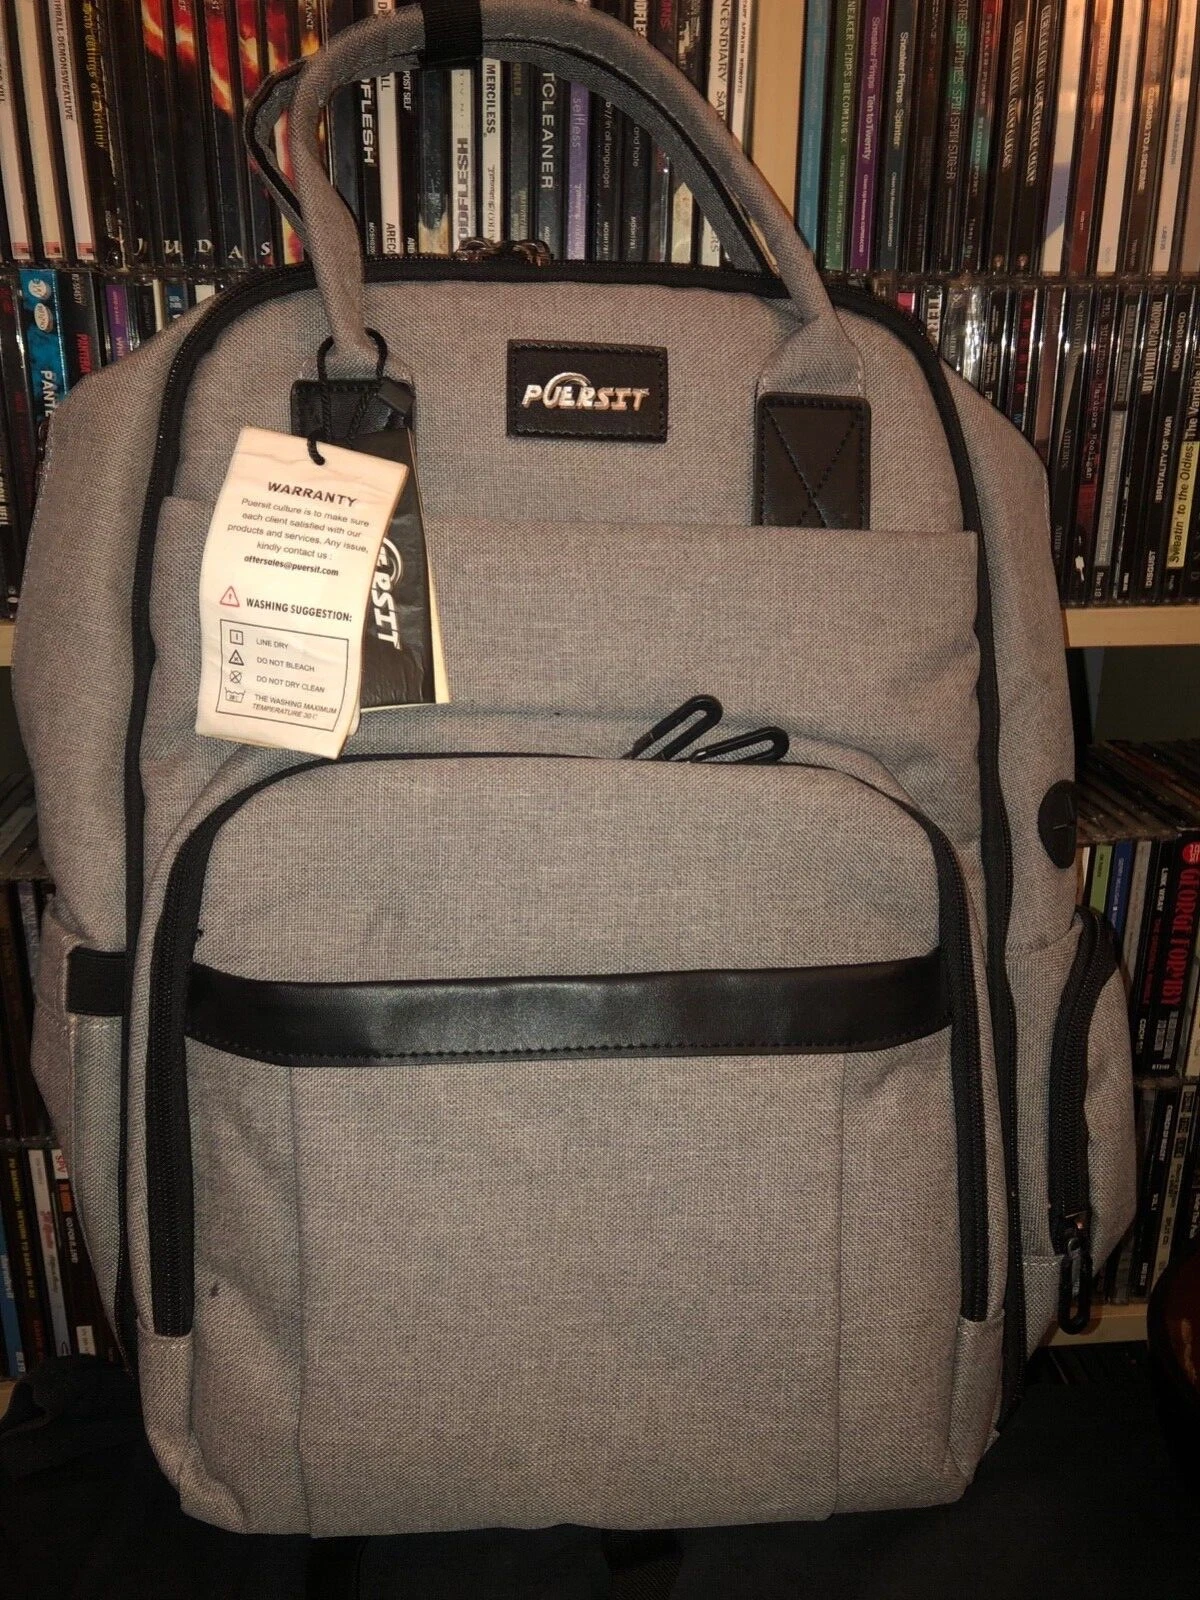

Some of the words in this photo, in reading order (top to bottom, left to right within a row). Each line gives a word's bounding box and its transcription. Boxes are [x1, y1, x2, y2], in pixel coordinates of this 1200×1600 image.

[844, 0, 857, 42] NEAKER
[869, 16, 881, 57] Sneaker
[717, 0, 732, 83] NCENDIARY
[898, 31, 910, 73] Sneaker
[843, 44, 853, 78] PIMPS
[866, 58, 877, 89] Pimps
[402, 70, 412, 91] POST
[895, 73, 906, 104] Pimps
[402, 92, 412, 111] SELF
[485, 64, 497, 135] MERCILESS
[840, 82, 850, 135] BECOMING
[866, 94, 876, 113] Ten
[360, 78, 375, 163] FLESH
[541, 72, 556, 189] TCLEANER
[571, 97, 589, 149] selfless
[893, 107, 905, 147] Splinter
[863, 123, 874, 161] Twenty
[457, 137, 469, 241] ODFLESH
[1147, 300, 1164, 346] DROPDEAD
[1171, 341, 1183, 370] MOSH
[40, 370, 56, 418] PANT
[522, 372, 650, 411] PUERSIT
[1163, 415, 1173, 437] WAR
[1184, 417, 1199, 440] The
[1084, 433, 1099, 480] Hooligan
[1161, 437, 1171, 451] OF
[1154, 452, 1169, 503] BRUTALITY
[1179, 484, 1189, 501] the
[267, 481, 357, 508] WARRANTY
[1177, 503, 1187, 515] to
[241, 497, 272, 510] Puersit
[272, 503, 302, 514] culture
[304, 508, 312, 516] is
[313, 510, 322, 518] to
[324, 511, 348, 523] make
[350, 518, 370, 528] sure
[242, 512, 263, 522] each
[264, 515, 288, 526] client
[289, 521, 325, 532] satisfied
[327, 525, 345, 536] with
[346, 530, 363, 538] our
[227, 523, 265, 535] products
[265, 528, 283, 538] and
[323, 537, 343, 549] Any
[256, 541, 283, 554] kindly
[283, 547, 316, 558] contact
[243, 554, 339, 577] aftersales@puersit.com
[1144, 549, 1156, 589] DISGUST
[246, 598, 289, 613] WASHING
[290, 603, 353, 622] SUGGESTION:
[371, 538, 402, 651] ERSIT
[256, 638, 273, 648] LINE
[273, 641, 289, 650] DRY
[256, 656, 269, 665] DO
[268, 658, 286, 668] NOT
[285, 661, 316, 673] BLEACH
[256, 674, 268, 683] DO
[268, 677, 285, 687] NOT
[284, 679, 301, 689] DRY
[301, 683, 326, 694] CLEAN
[252, 703, 304, 718] TEMPERATURE
[254, 693, 269, 702] THE
[269, 696, 303, 709] WASHING
[303, 702, 338, 714] MAXIMUM
[1156, 887, 1167, 912] WRAY
[1171, 867, 1200, 934] GEORGE
[1160, 937, 1192, 1006] FORMBY
[55, 1154, 67, 1175] SPV
